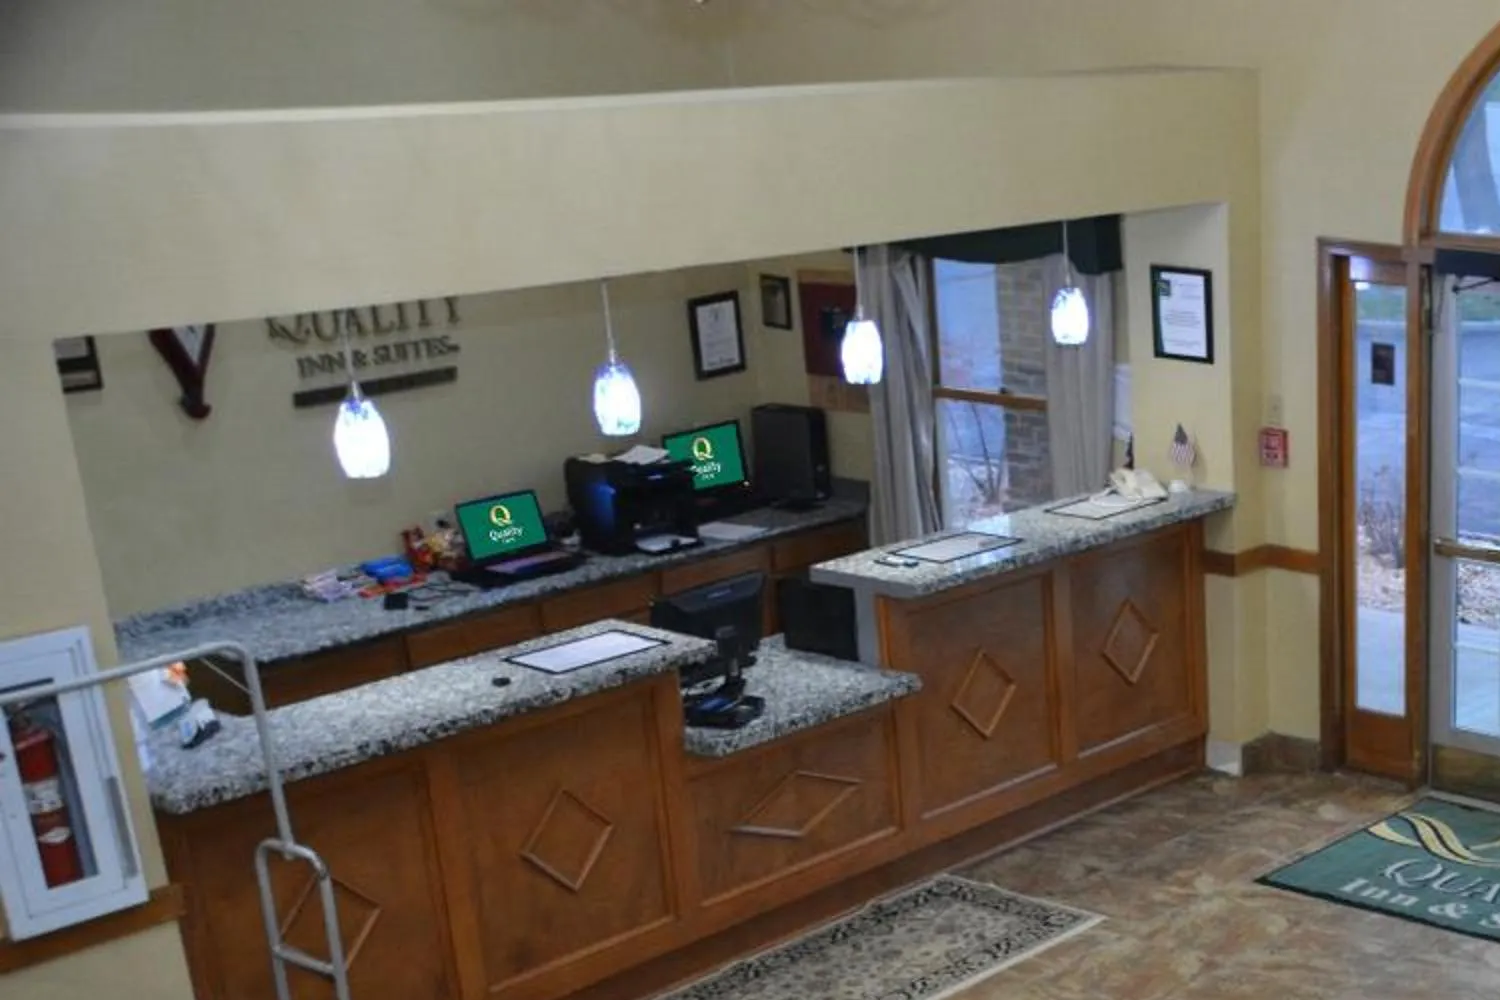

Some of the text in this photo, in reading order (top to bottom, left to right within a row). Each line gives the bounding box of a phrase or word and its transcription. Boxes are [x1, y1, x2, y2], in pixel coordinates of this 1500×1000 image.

[296, 351, 346, 379] INN
[1339, 877, 1420, 907] Inn
[1427, 902, 1469, 920] &
